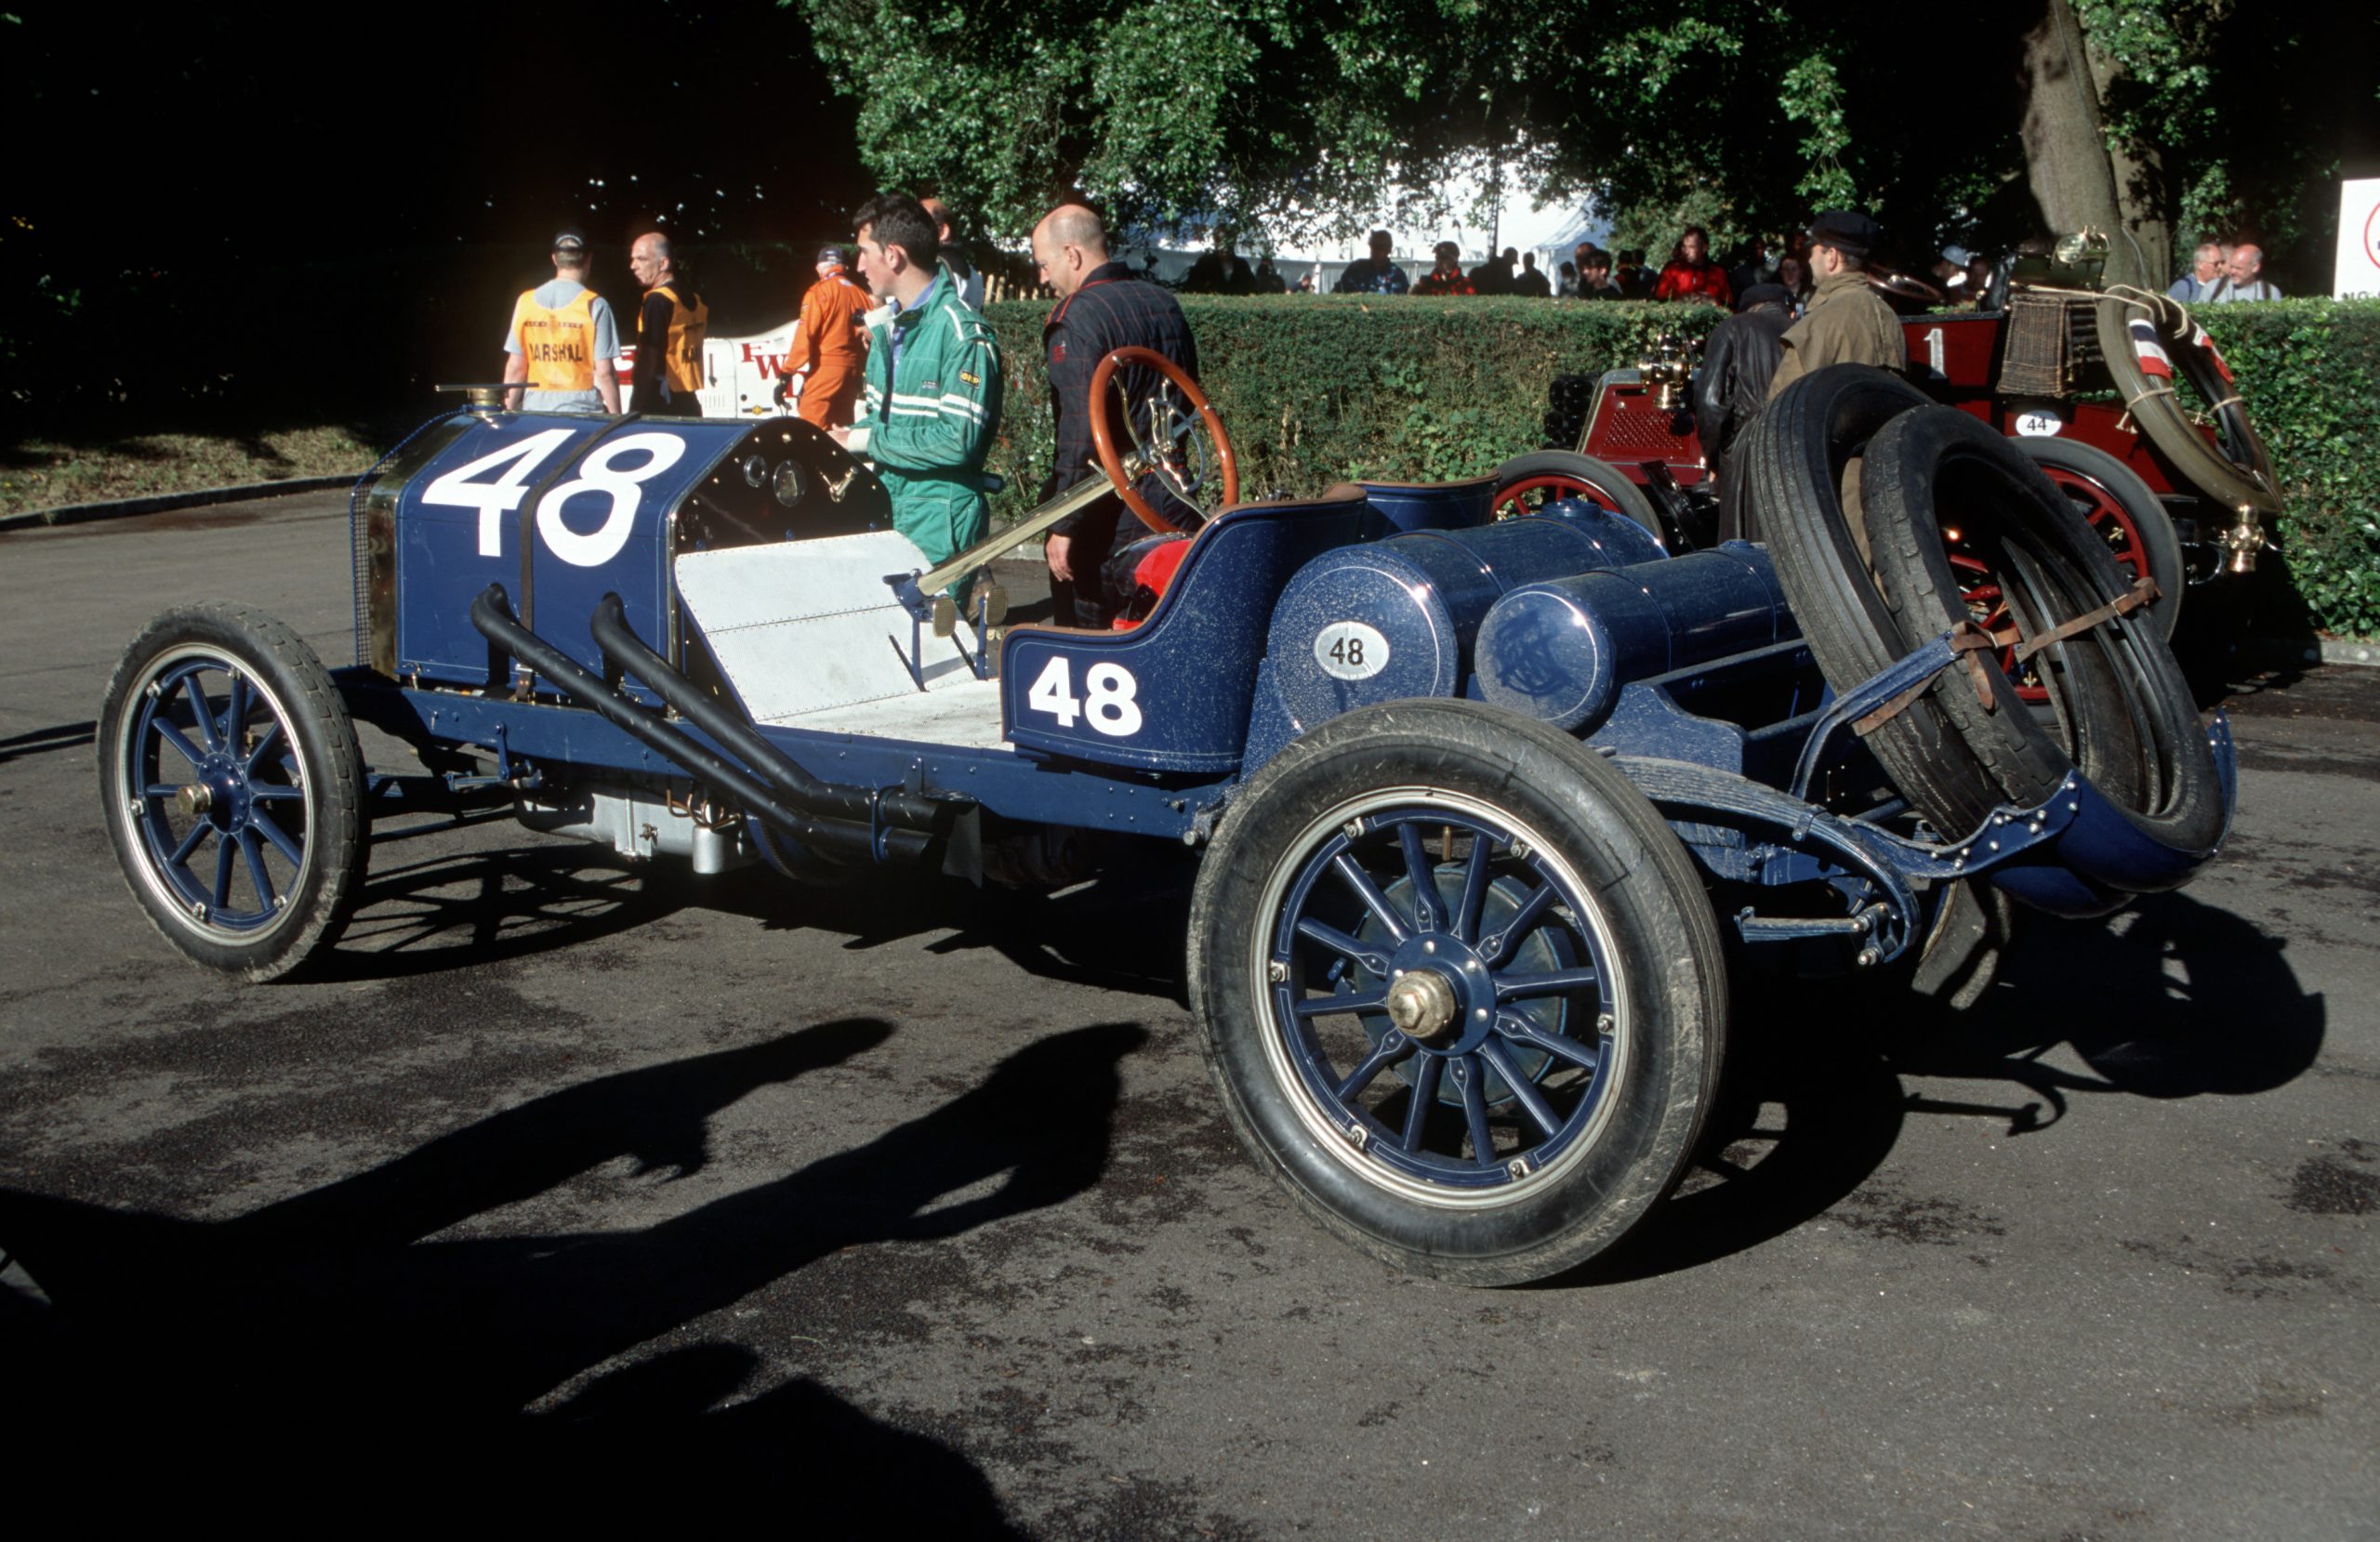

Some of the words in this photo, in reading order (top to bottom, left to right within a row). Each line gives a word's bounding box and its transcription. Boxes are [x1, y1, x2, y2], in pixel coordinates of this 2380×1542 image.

[2027, 416, 2047, 431] 44
[421, 428, 686, 567] 48
[1329, 637, 1364, 666] 48
[1028, 656, 1143, 736] 48
